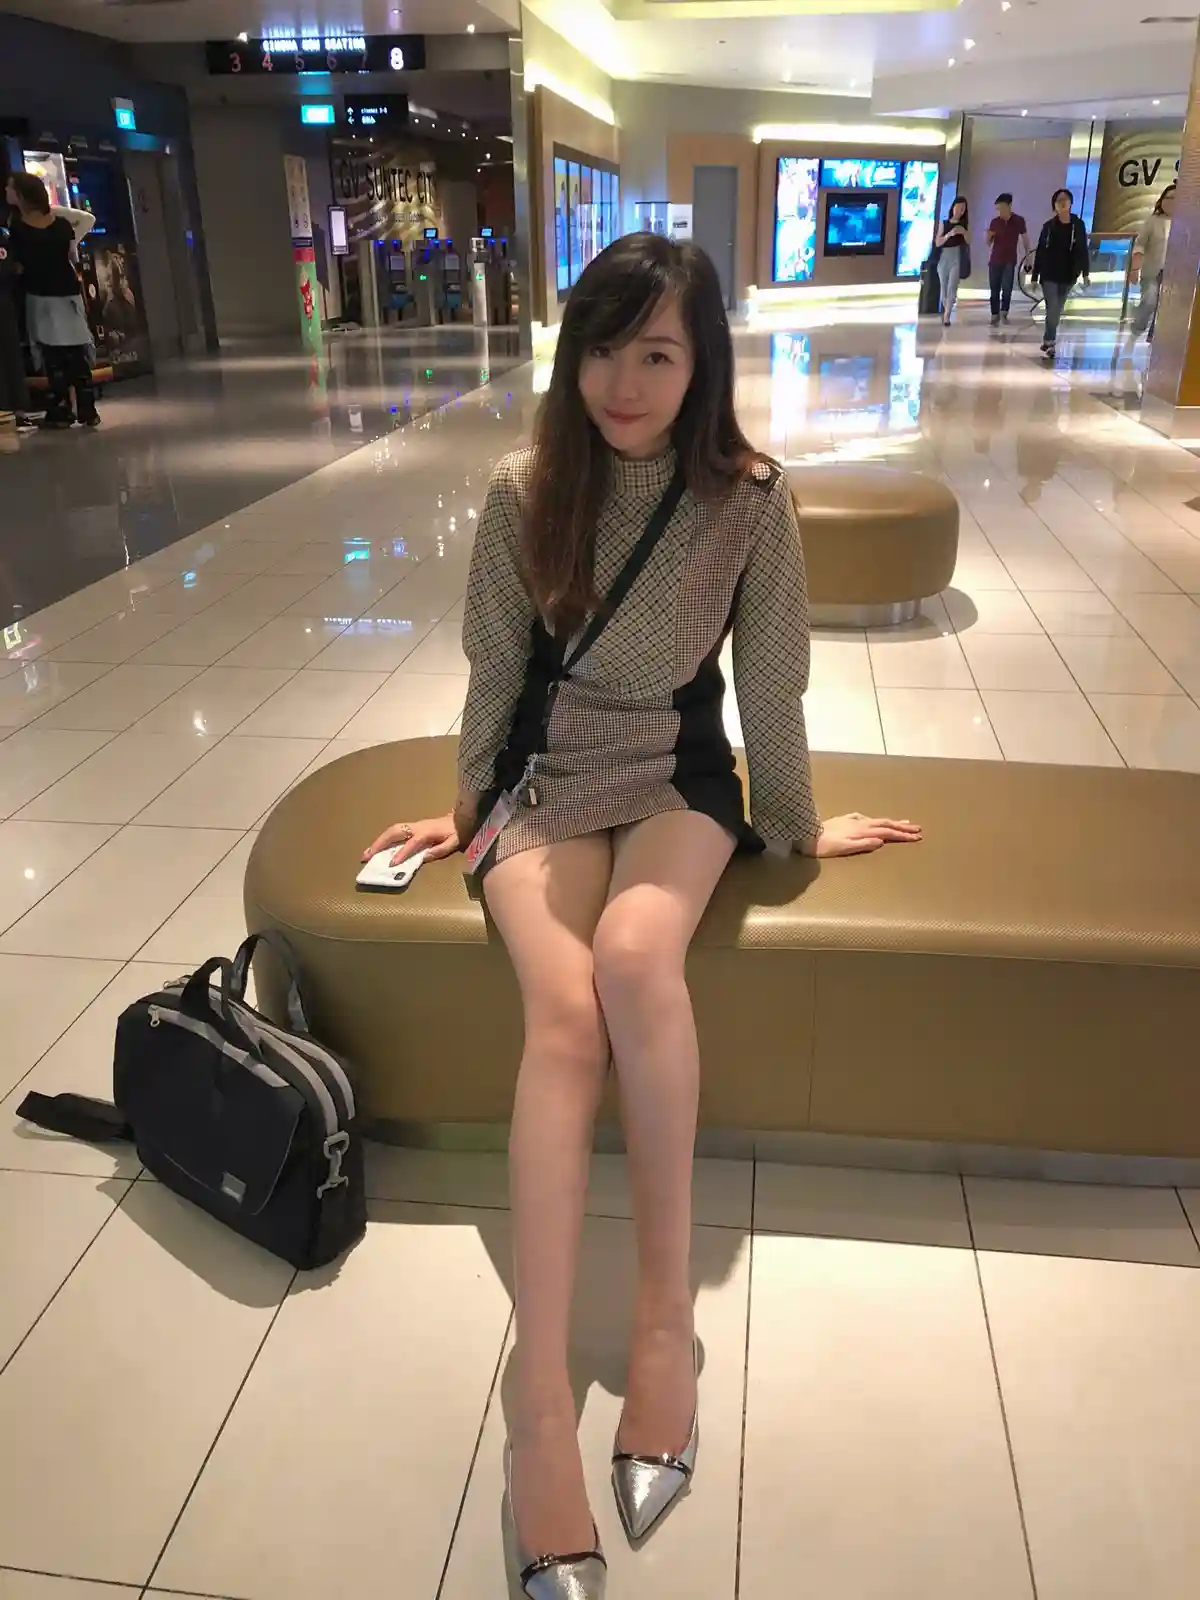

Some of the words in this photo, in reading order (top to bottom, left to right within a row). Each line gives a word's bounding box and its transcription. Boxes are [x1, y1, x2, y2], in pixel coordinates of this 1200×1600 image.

[229, 52, 241, 72] 3
[262, 51, 274, 71] 4
[390, 47, 404, 70] 8
[365, 163, 413, 203] SUNTEC
[1118, 158, 1162, 187] GV
